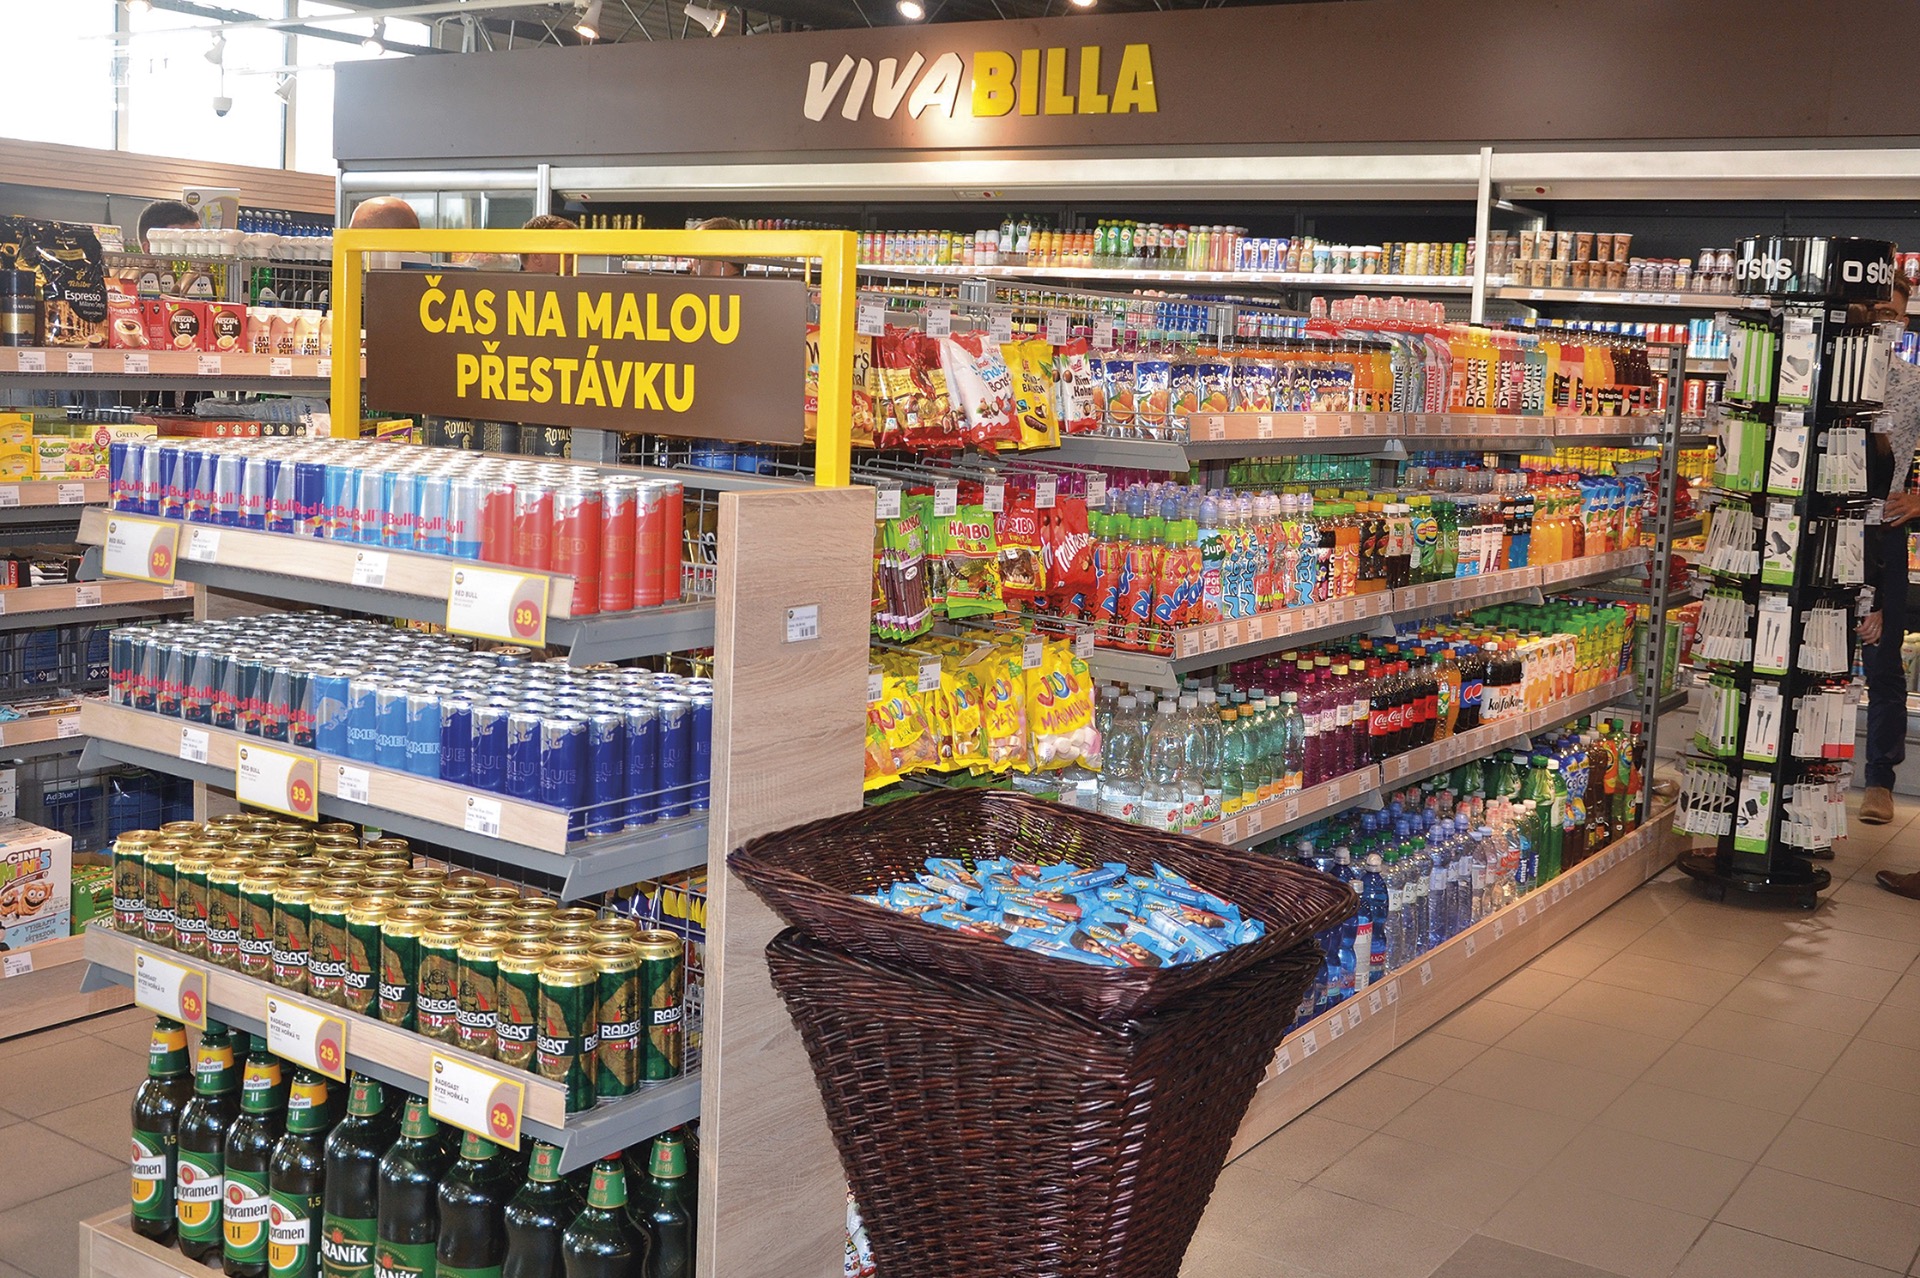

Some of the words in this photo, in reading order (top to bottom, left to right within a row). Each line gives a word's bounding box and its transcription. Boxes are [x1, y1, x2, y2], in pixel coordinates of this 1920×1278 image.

[803, 52, 964, 122] VIVA
[973, 43, 1158, 118] BILLA
[1749, 252, 1793, 280] sbs
[64, 289, 102, 301] Espresso
[419, 274, 497, 336] ČAS
[506, 289, 568, 338] NA
[577, 291, 741, 345] MALOU
[456, 340, 696, 413] PŘESTÁVKU
[45, 791, 76, 802] AdBlue
[7, 849, 40, 865] CINI
[124, 912, 135, 924] 12
[147, 921, 156, 933] 12
[181, 933, 191, 944] 12
[212, 943, 222, 955] 12
[241, 953, 250, 965] 12
[275, 965, 284, 977] 12
[314, 976, 325, 989] 12
[654, 1004, 682, 1024] RADE
[430, 1015, 442, 1028] 12
[462, 1027, 472, 1040] 12
[601, 1022, 641, 1039] RADEG
[498, 1038, 506, 1051] 12
[628, 1037, 638, 1050] 12
[163, 1135, 177, 1145] 1,5
[307, 1197, 321, 1208] 1,5
